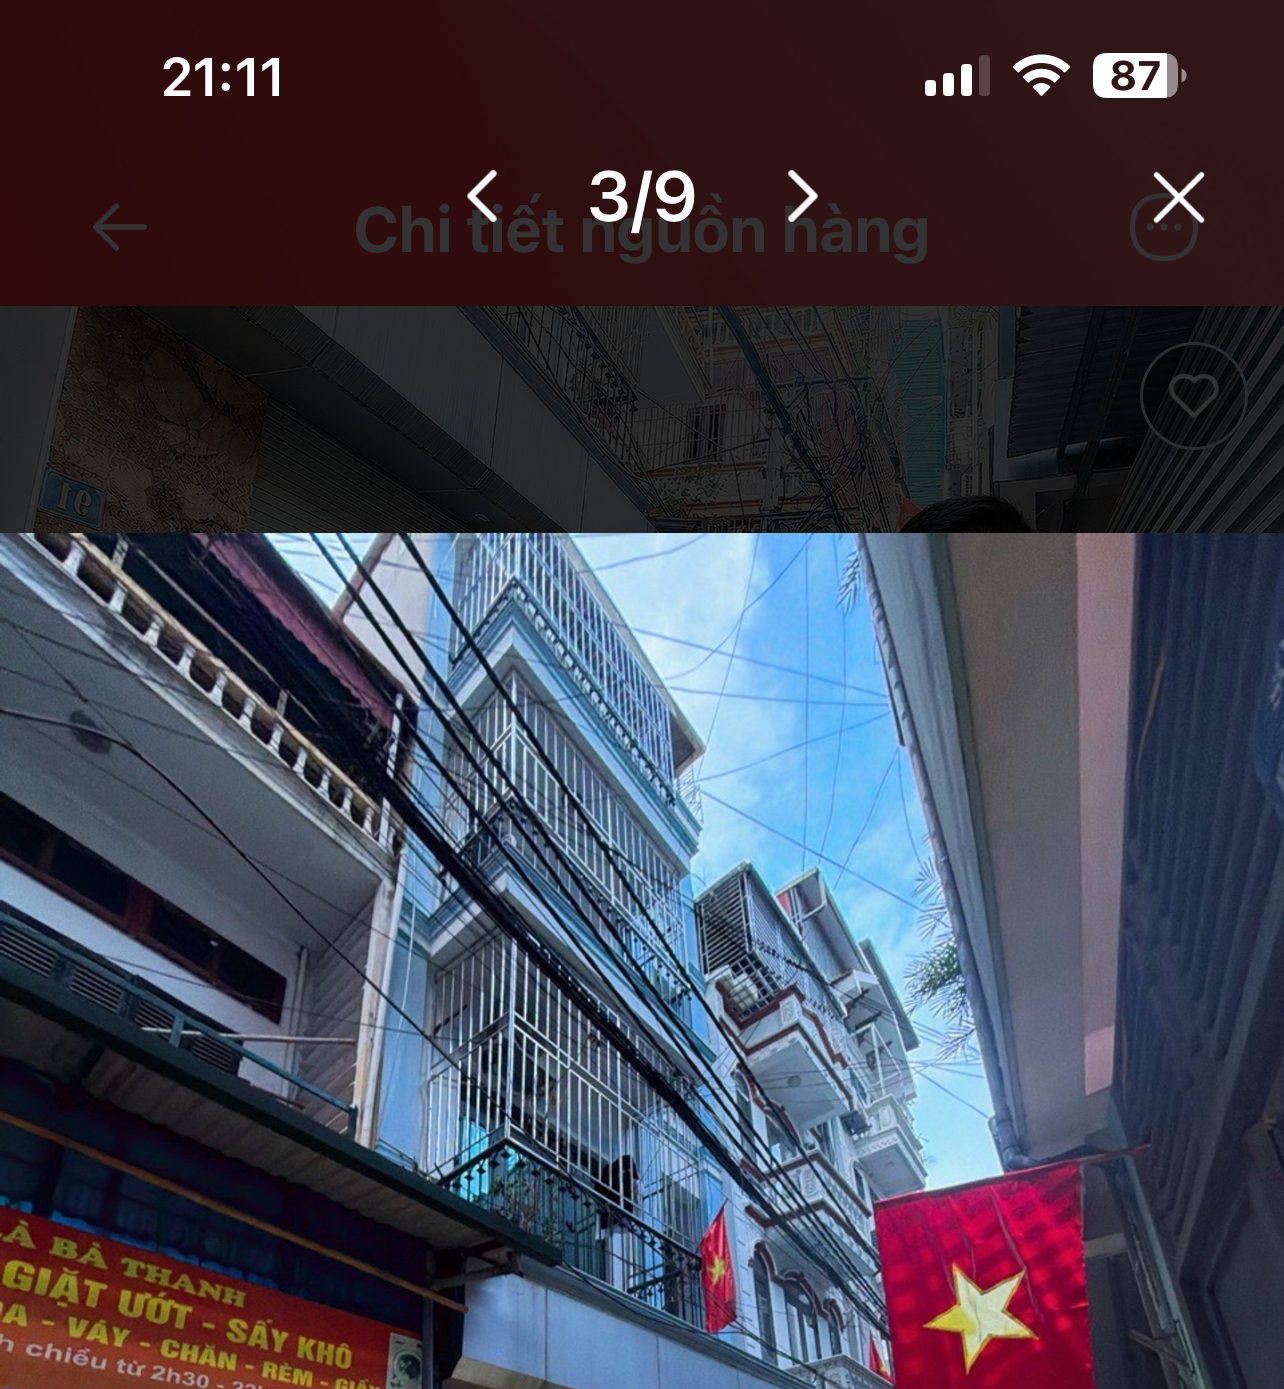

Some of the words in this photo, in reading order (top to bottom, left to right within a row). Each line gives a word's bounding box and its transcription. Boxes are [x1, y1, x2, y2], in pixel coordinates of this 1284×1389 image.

[0, 1220, 36, 1250] À
[49, 1236, 109, 1270] BÀ
[121, 1257, 247, 1309] THANH
[2, 1259, 108, 1309] GIẶT
[118, 1289, 193, 1330] ƯỚT
[226, 1318, 289, 1354] SẤY
[297, 1336, 352, 1370] KHÔ
[68, 1315, 130, 1348] VÁY
[161, 1337, 238, 1371] CHĂN
[262, 1361, 313, 1388] RÈM
[25, 1343, 107, 1371] chiều
[116, 1358, 146, 1378] từ
[151, 1364, 210, 1389] 2h30
